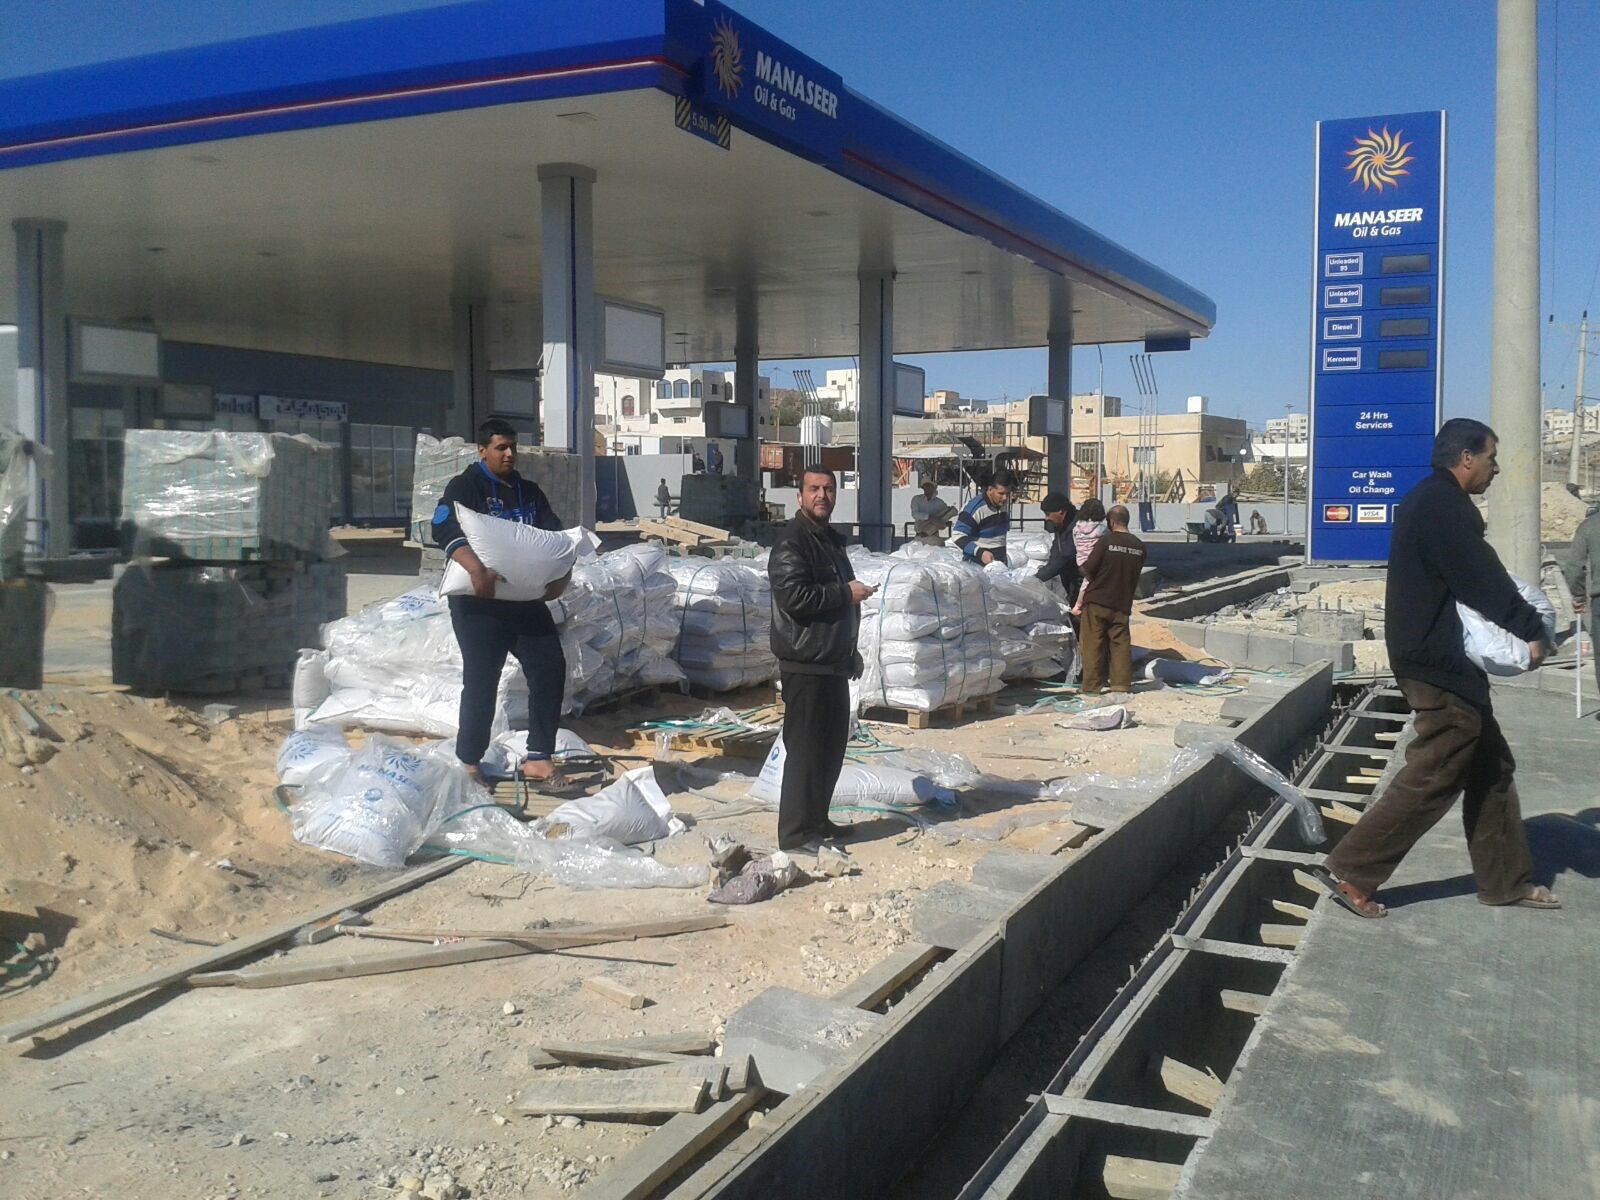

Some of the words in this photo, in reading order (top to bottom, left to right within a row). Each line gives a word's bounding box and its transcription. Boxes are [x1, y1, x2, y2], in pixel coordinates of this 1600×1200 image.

[755, 50, 838, 119] MANASEER
[754, 85, 768, 106] Oil
[769, 92, 778, 111] &
[779, 97, 796, 120] Gas
[1334, 208, 1423, 227] MANASEER
[1353, 227, 1367, 237] Oil
[1370, 226, 1379, 236] &
[1381, 225, 1402, 235] Gas
[1360, 412, 1372, 420] 24
[1355, 421, 1393, 429] Services
[1352, 471, 1368, 479] Car
[1363, 486, 1395, 495] Change
